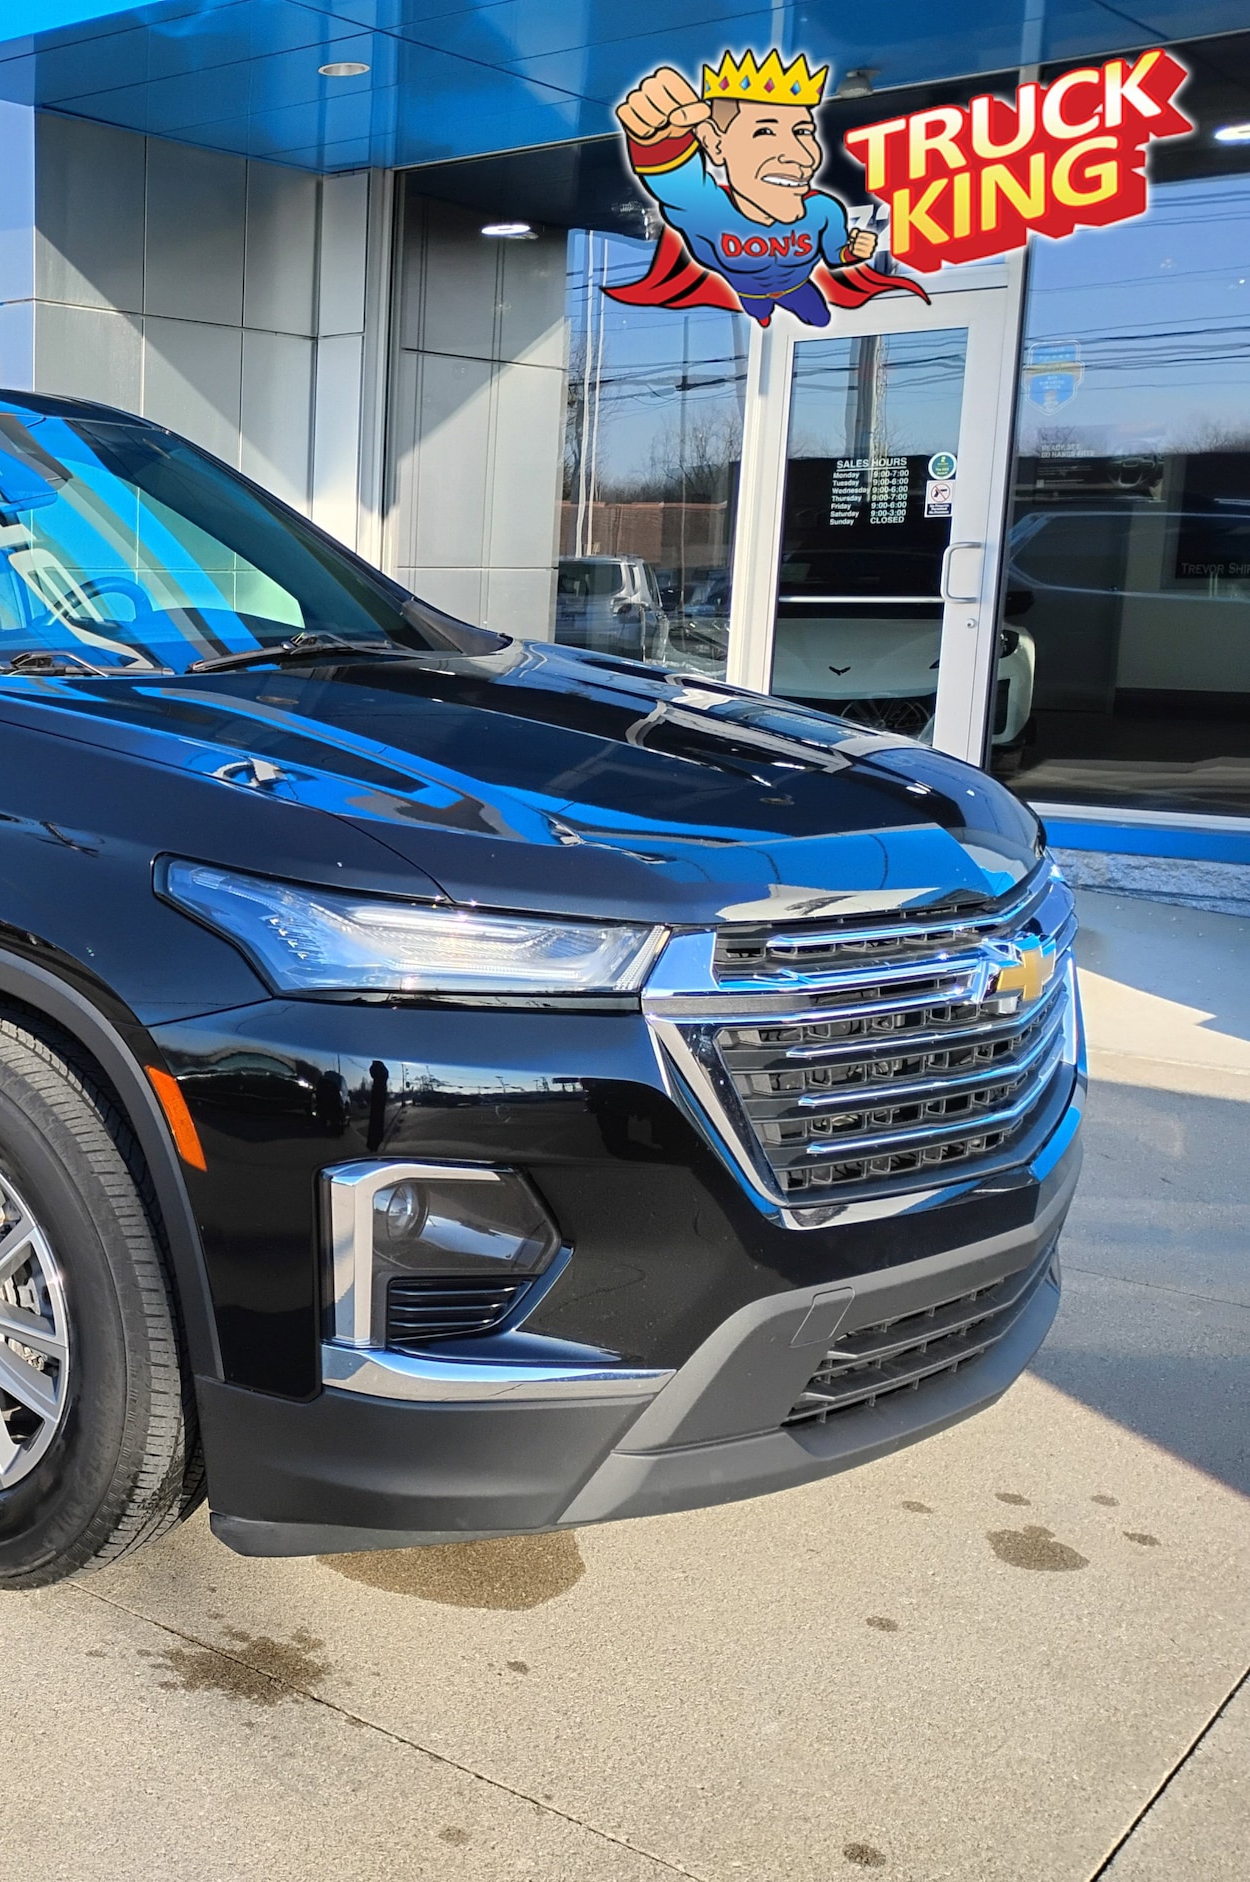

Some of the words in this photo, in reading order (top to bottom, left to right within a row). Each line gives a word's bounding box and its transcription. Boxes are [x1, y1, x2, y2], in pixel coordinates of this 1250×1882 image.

[836, 460, 869, 469] SALES
[871, 457, 907, 467] HOURS
[873, 469, 909, 477] 9:00-7:00
[832, 487, 870, 495] Wednesday
[871, 493, 908, 501] 9:00-7:00
[871, 501, 907, 509] 9:00-6:00
[830, 510, 860, 518] Saturday
[870, 509, 907, 517] 9:00-3:00
[829, 518, 855, 526] Sunday
[870, 516, 905, 524] CLOSED
[1181, 562, 1225, 575] TREVOR
